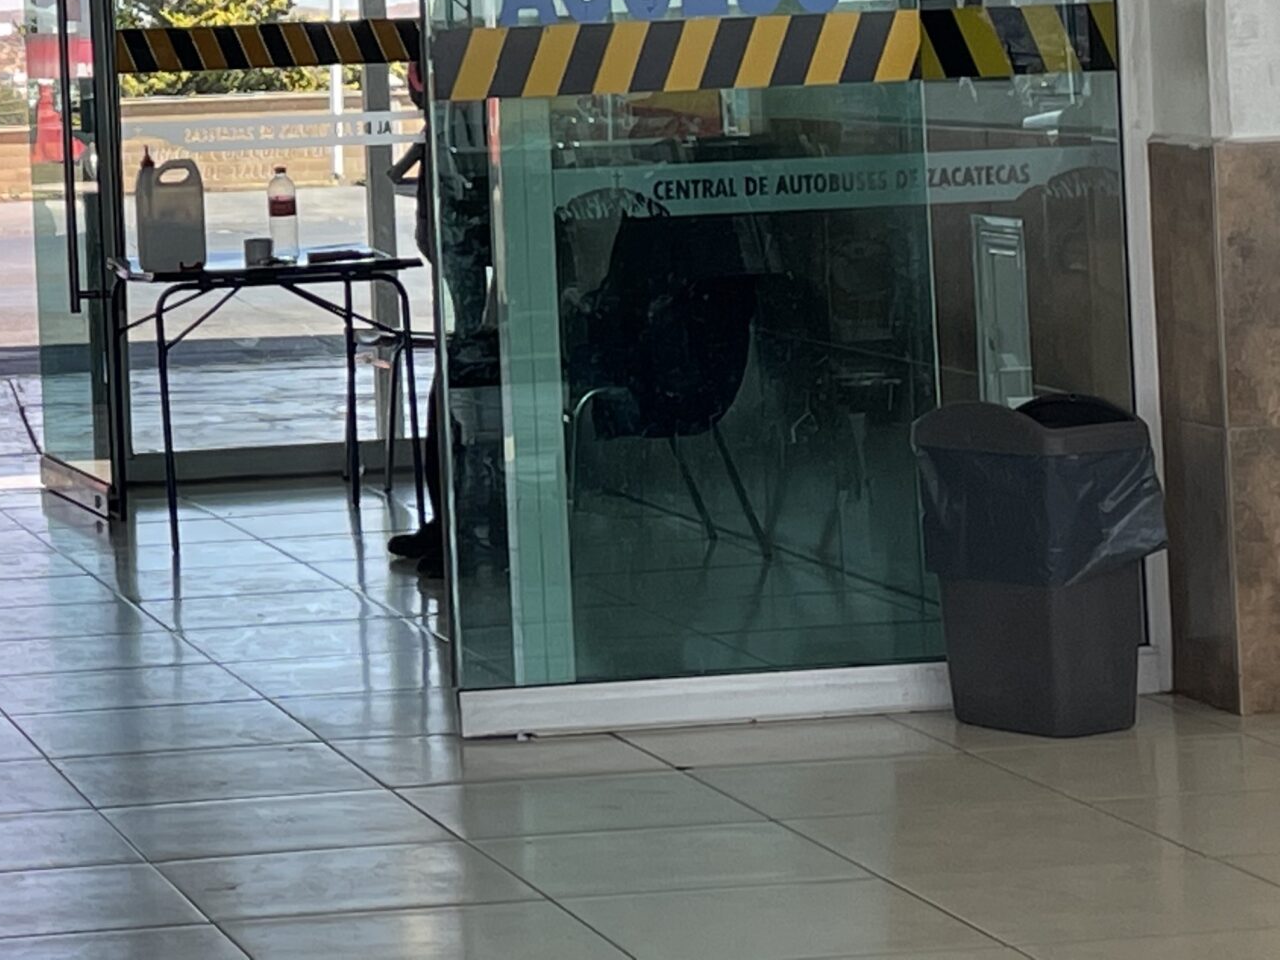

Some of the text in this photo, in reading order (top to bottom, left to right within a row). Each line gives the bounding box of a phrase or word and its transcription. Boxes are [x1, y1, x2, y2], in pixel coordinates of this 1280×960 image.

[653, 162, 1031, 201] CENTRAL DE AUTOBUSES DE ZACATECAS
